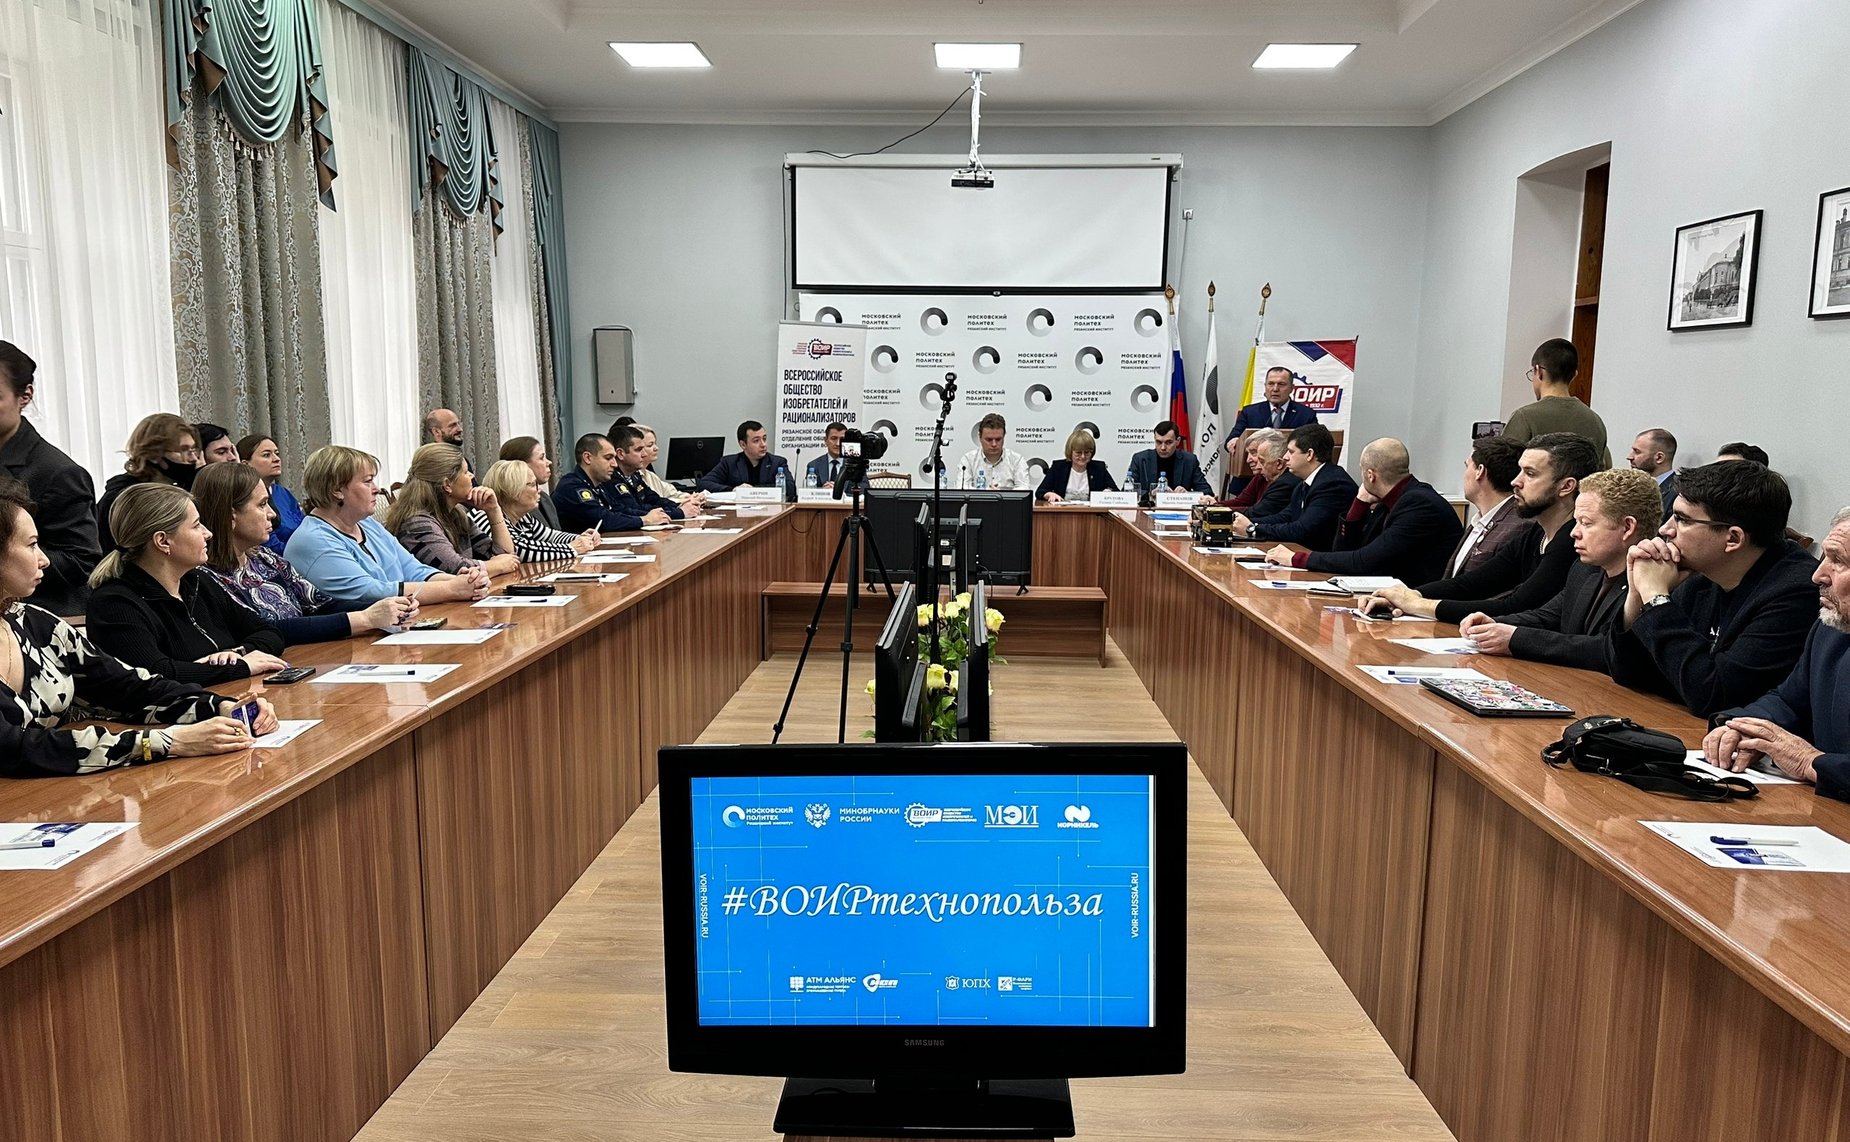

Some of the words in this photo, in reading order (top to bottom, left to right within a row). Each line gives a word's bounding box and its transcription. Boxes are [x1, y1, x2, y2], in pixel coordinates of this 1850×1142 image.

[784, 369, 842, 381] ВСЕРОССИЙСКОЕ
[783, 384, 822, 395] ОБЩЕСТВО
[783, 397, 841, 409] ИЗОБРЕТАТЕЛЕЙ
[842, 399, 848, 409] И
[782, 412, 856, 424] РАЦИОНАЛИЗАТОРОВ
[746, 806, 794, 814] МОСКОВСКИЙ
[839, 807, 900, 815] МИНОБРНАУКИ
[984, 805, 1039, 825] МЭИ
[699, 873, 709, 939] VOIR-RUSSIA.RU
[721, 882, 1104, 923] #ВОИРтехнопольза
[1131, 872, 1139, 939] VOIR-RUSSIA.RU
[962, 978, 991, 988] ЮПХ
[904, 1039, 945, 1047] SAMSUNG
